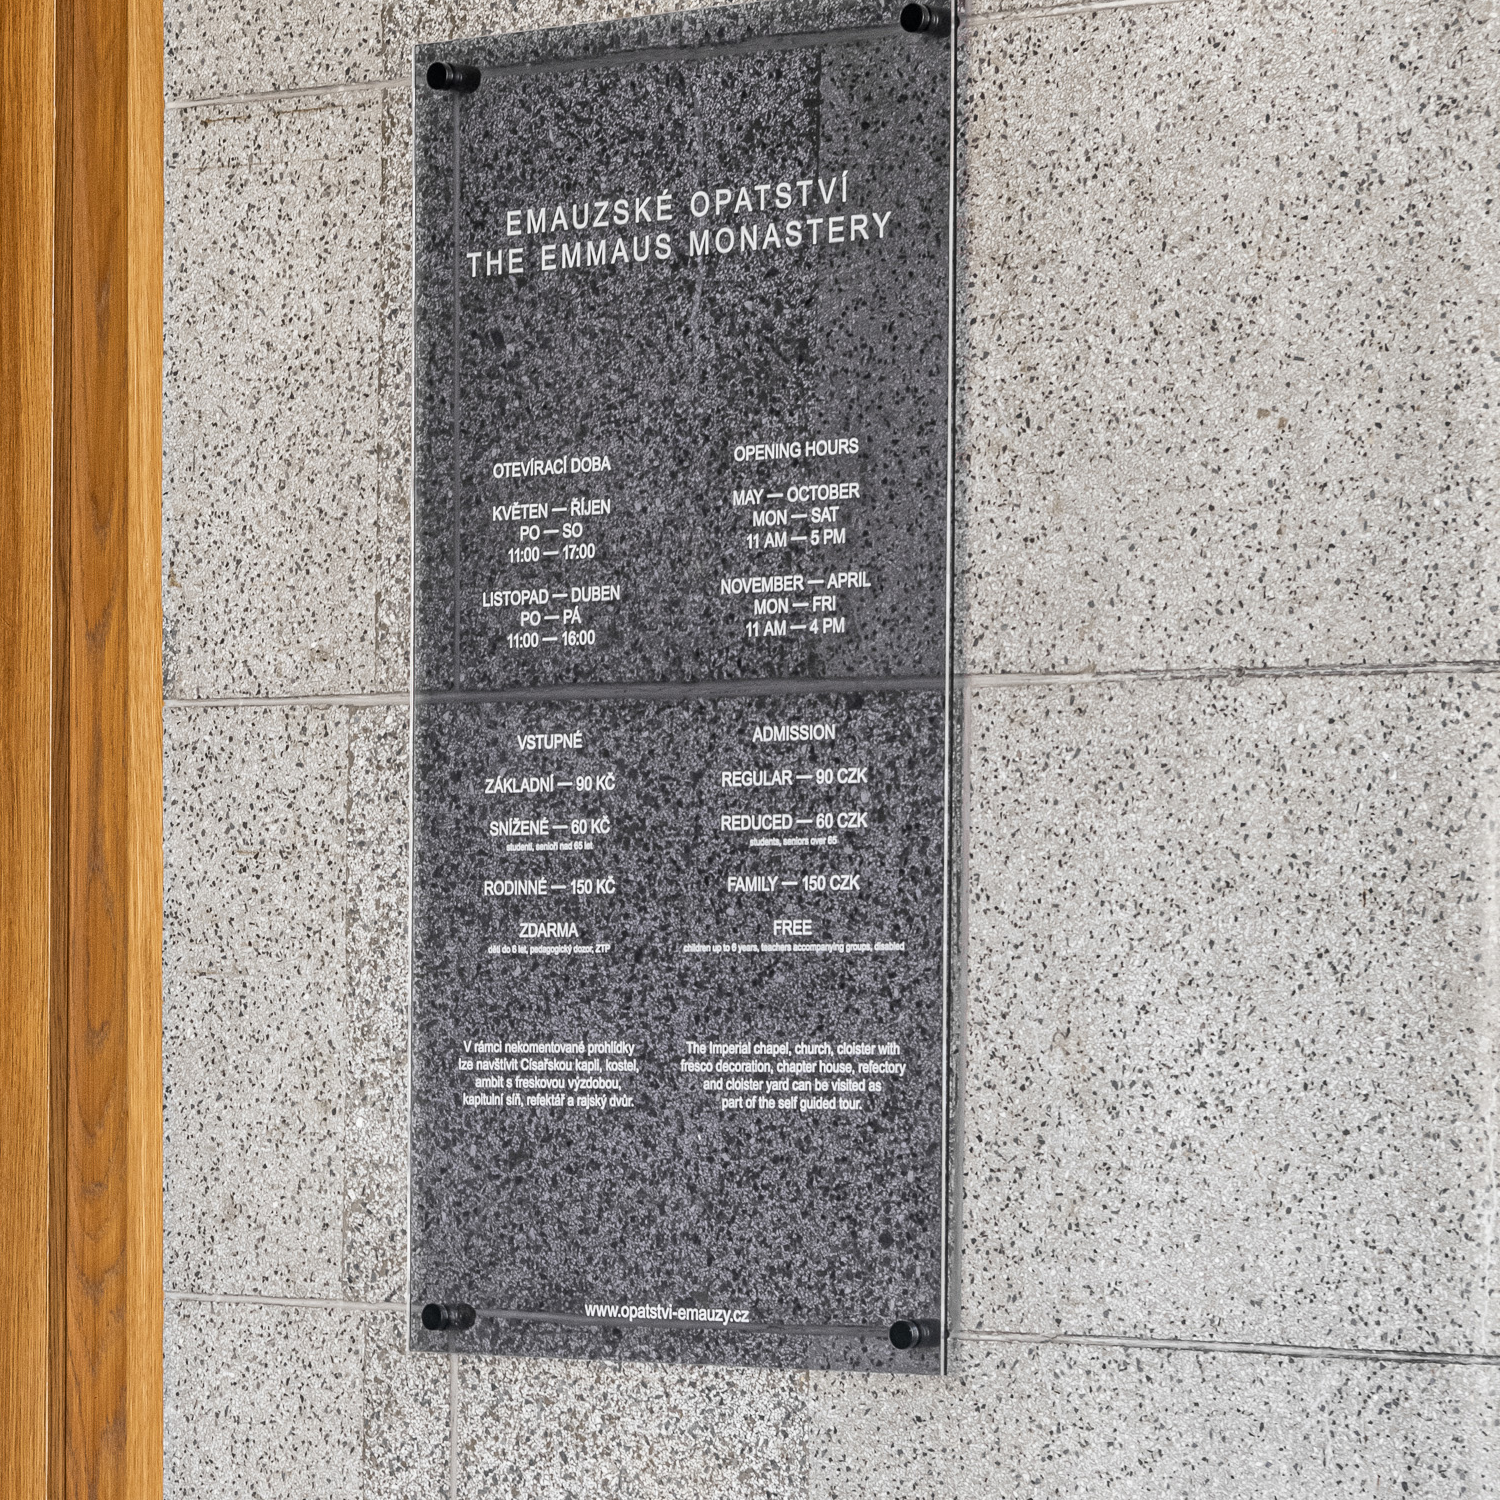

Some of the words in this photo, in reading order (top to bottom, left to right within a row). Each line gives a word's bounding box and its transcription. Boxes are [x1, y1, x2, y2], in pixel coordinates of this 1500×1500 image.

[507, 189, 672, 236] EMAUZSKÉ
[691, 171, 848, 217] OPATSTVÍ
[467, 248, 523, 277] THE
[542, 234, 671, 270] EMMAUS
[690, 212, 890, 256] MONASTERY
[734, 442, 801, 461] OPENING
[806, 438, 858, 456] HOURS
[494, 455, 567, 478] OTEVÍRACÍ
[571, 456, 611, 473] DOBA
[733, 489, 763, 506] MAY
[787, 483, 859, 502] OCTOBER
[493, 502, 547, 521] KVĚTEN
[571, 498, 610, 515] ŘÍJEN
[753, 510, 787, 526] MON
[812, 506, 839, 523] SAT
[521, 525, 539, 541] PO
[563, 522, 582, 538] SO
[747, 534, 758, 548] 11
[764, 532, 786, 548] AM
[811, 530, 819, 545] 5
[824, 528, 845, 544] PM
[509, 547, 539, 562] 11:00
[563, 543, 595, 559] 17:00
[721, 575, 804, 594] NOVEMBER
[828, 572, 870, 588] APRIL
[483, 590, 548, 607] LISTOPAD
[572, 585, 620, 602] DUBEN
[755, 598, 788, 614] MON
[813, 596, 835, 611] FRI
[521, 611, 540, 625] PO
[564, 606, 581, 624] PÁ
[746, 622, 758, 636] 11
[764, 620, 786, 636] AM
[810, 619, 818, 634] 4
[823, 618, 844, 632] PM
[508, 633, 538, 648] 11:00
[562, 630, 595, 645] 16:00
[518, 730, 582, 750] VSTUPNÉ
[753, 724, 835, 742] ADMISSION
[485, 774, 553, 793] ZÁKLADNÍ
[577, 776, 592, 791] 90
[597, 772, 615, 790] KČ
[722, 770, 792, 787] REGULAR
[816, 769, 833, 784] 90
[838, 767, 867, 783] CZK
[490, 818, 548, 835] SNÍŽENÉ
[572, 819, 587, 834] 60
[592, 816, 610, 834] KČ
[722, 814, 792, 830] REDUCED
[817, 814, 833, 828] 60
[838, 812, 867, 827] CZK
[485, 877, 547, 895] RODINNÉ
[571, 879, 592, 894] 150
[597, 876, 615, 893] KČ
[728, 877, 778, 891] FAMILY
[803, 875, 825, 890] 150
[830, 875, 860, 890] CZK
[519, 923, 578, 937] ZDARMA
[774, 920, 812, 935] FREE
[464, 1040, 471, 1052] V
[475, 1040, 501, 1052] rámci
[505, 1041, 584, 1053] nekomentované
[588, 1041, 635, 1056] prohlídky
[686, 1042, 706, 1054] The
[710, 1042, 751, 1057] Imperial
[754, 1042, 791, 1056] chapel,
[795, 1042, 833, 1056] church,
[837, 1042, 876, 1055] cloister
[878, 1042, 900, 1055] with
[459, 1058, 473, 1069] lze
[477, 1058, 518, 1070] navštívit
[521, 1058, 572, 1070] Císařskou
[576, 1059, 602, 1073] kapli,
[606, 1059, 639, 1072] kostel,
[681, 1059, 713, 1072] fresco
[716, 1060, 773, 1074] decoration,
[777, 1060, 816, 1075] chapter
[820, 1061, 854, 1075] house,
[859, 1060, 906, 1076] refectory
[475, 1075, 503, 1088] ambit
[507, 1079, 512, 1088] s
[515, 1076, 564, 1088] freskovou
[568, 1076, 621, 1091] výzdobou,
[703, 1077, 723, 1089] and
[726, 1077, 763, 1090] cloister
[766, 1078, 789, 1093] yard
[792, 1081, 811, 1090] can
[815, 1078, 828, 1090] be
[832, 1078, 865, 1091] visited
[869, 1082, 881, 1091] as
[463, 1093, 503, 1107] kapitulní
[506, 1093, 523, 1107] síň,
[527, 1093, 565, 1105] refektář
[568, 1097, 574, 1105] a
[577, 1094, 607, 1109] rajský
[610, 1095, 635, 1107] dvůr.
[722, 1096, 743, 1111] part
[746, 1096, 756, 1108] of
[759, 1096, 775, 1108] the
[779, 1097, 797, 1109] self
[800, 1097, 836, 1112] guided
[839, 1098, 862, 1109] tour.
[584, 1304, 750, 1325] www.opatstvi-emauzy.cz
